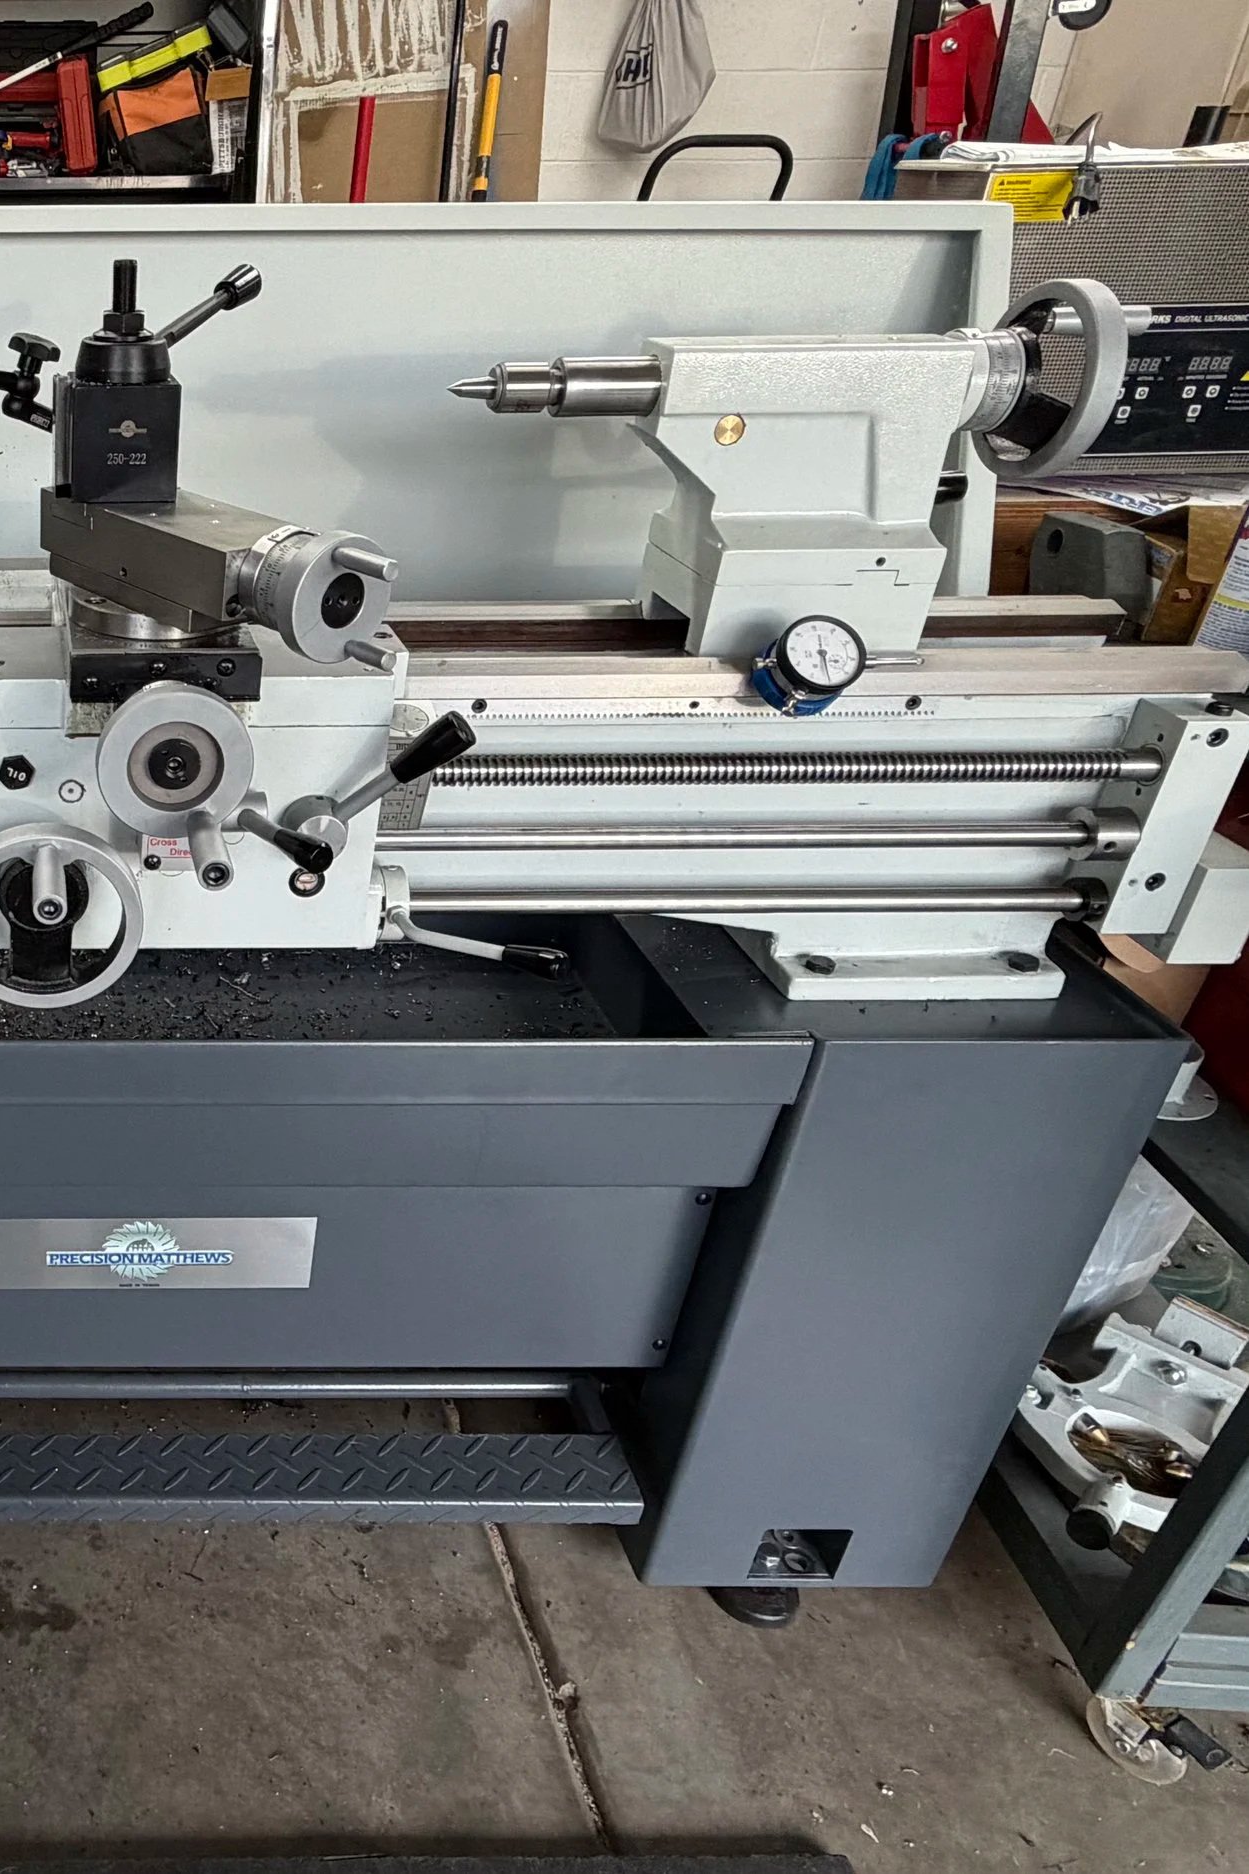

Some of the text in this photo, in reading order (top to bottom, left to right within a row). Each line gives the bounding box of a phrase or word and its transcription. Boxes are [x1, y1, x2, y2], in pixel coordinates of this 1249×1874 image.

[1174, 315, 1202, 323] DIGITAL
[106, 453, 147, 465] 250-222
[6, 766, 27, 783] OIL
[150, 837, 177, 847] Cross
[49, 1252, 231, 1265] PRECISION MATTHEWS
